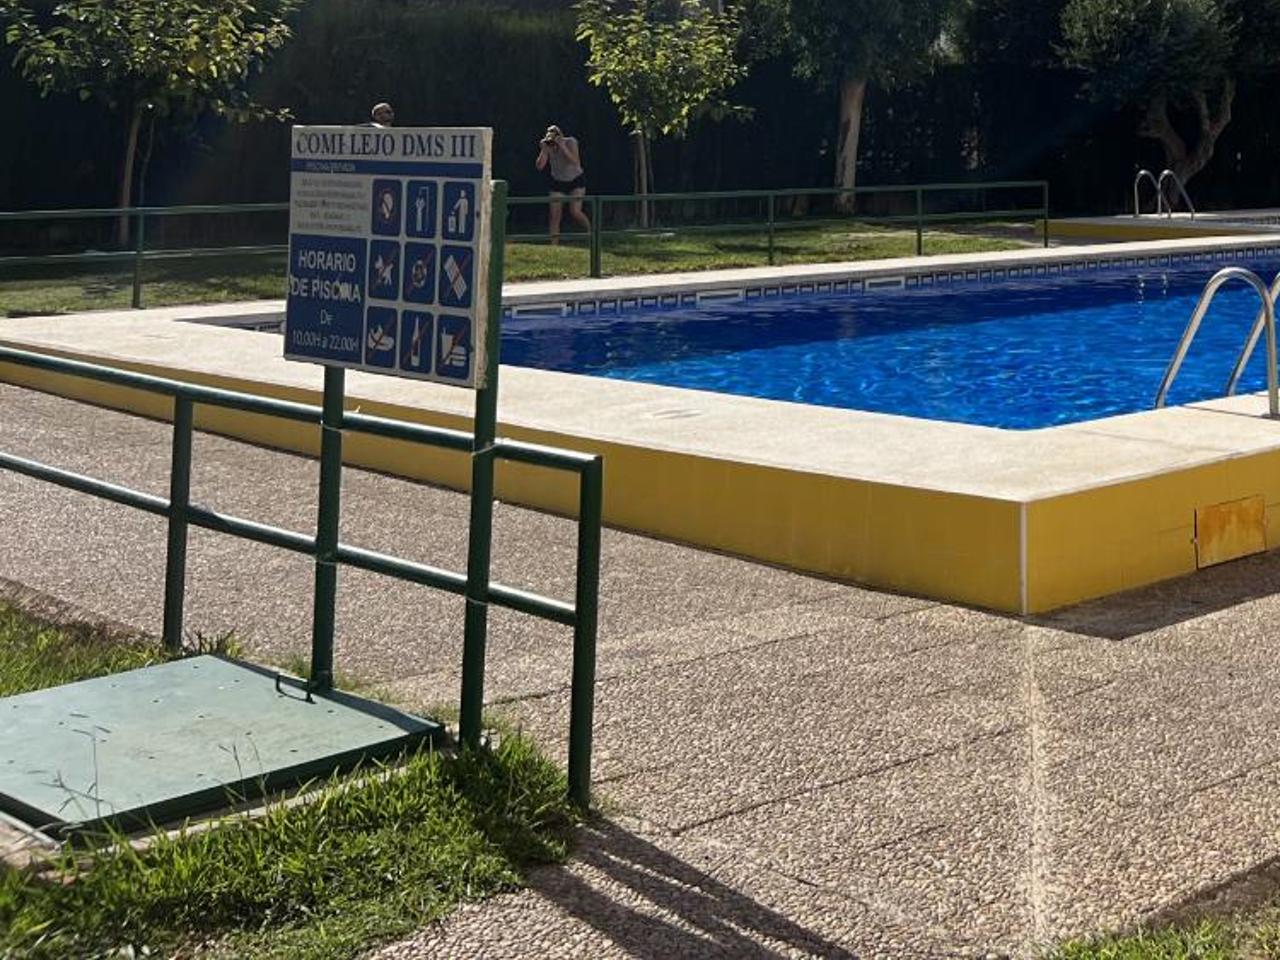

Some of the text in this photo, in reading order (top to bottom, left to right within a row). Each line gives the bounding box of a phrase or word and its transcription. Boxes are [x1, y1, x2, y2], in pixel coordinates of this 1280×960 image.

[402, 134, 445, 158] DMS
[450, 135, 476, 158] III
[298, 250, 356, 272] HORARIO
[290, 276, 308, 297] DE
